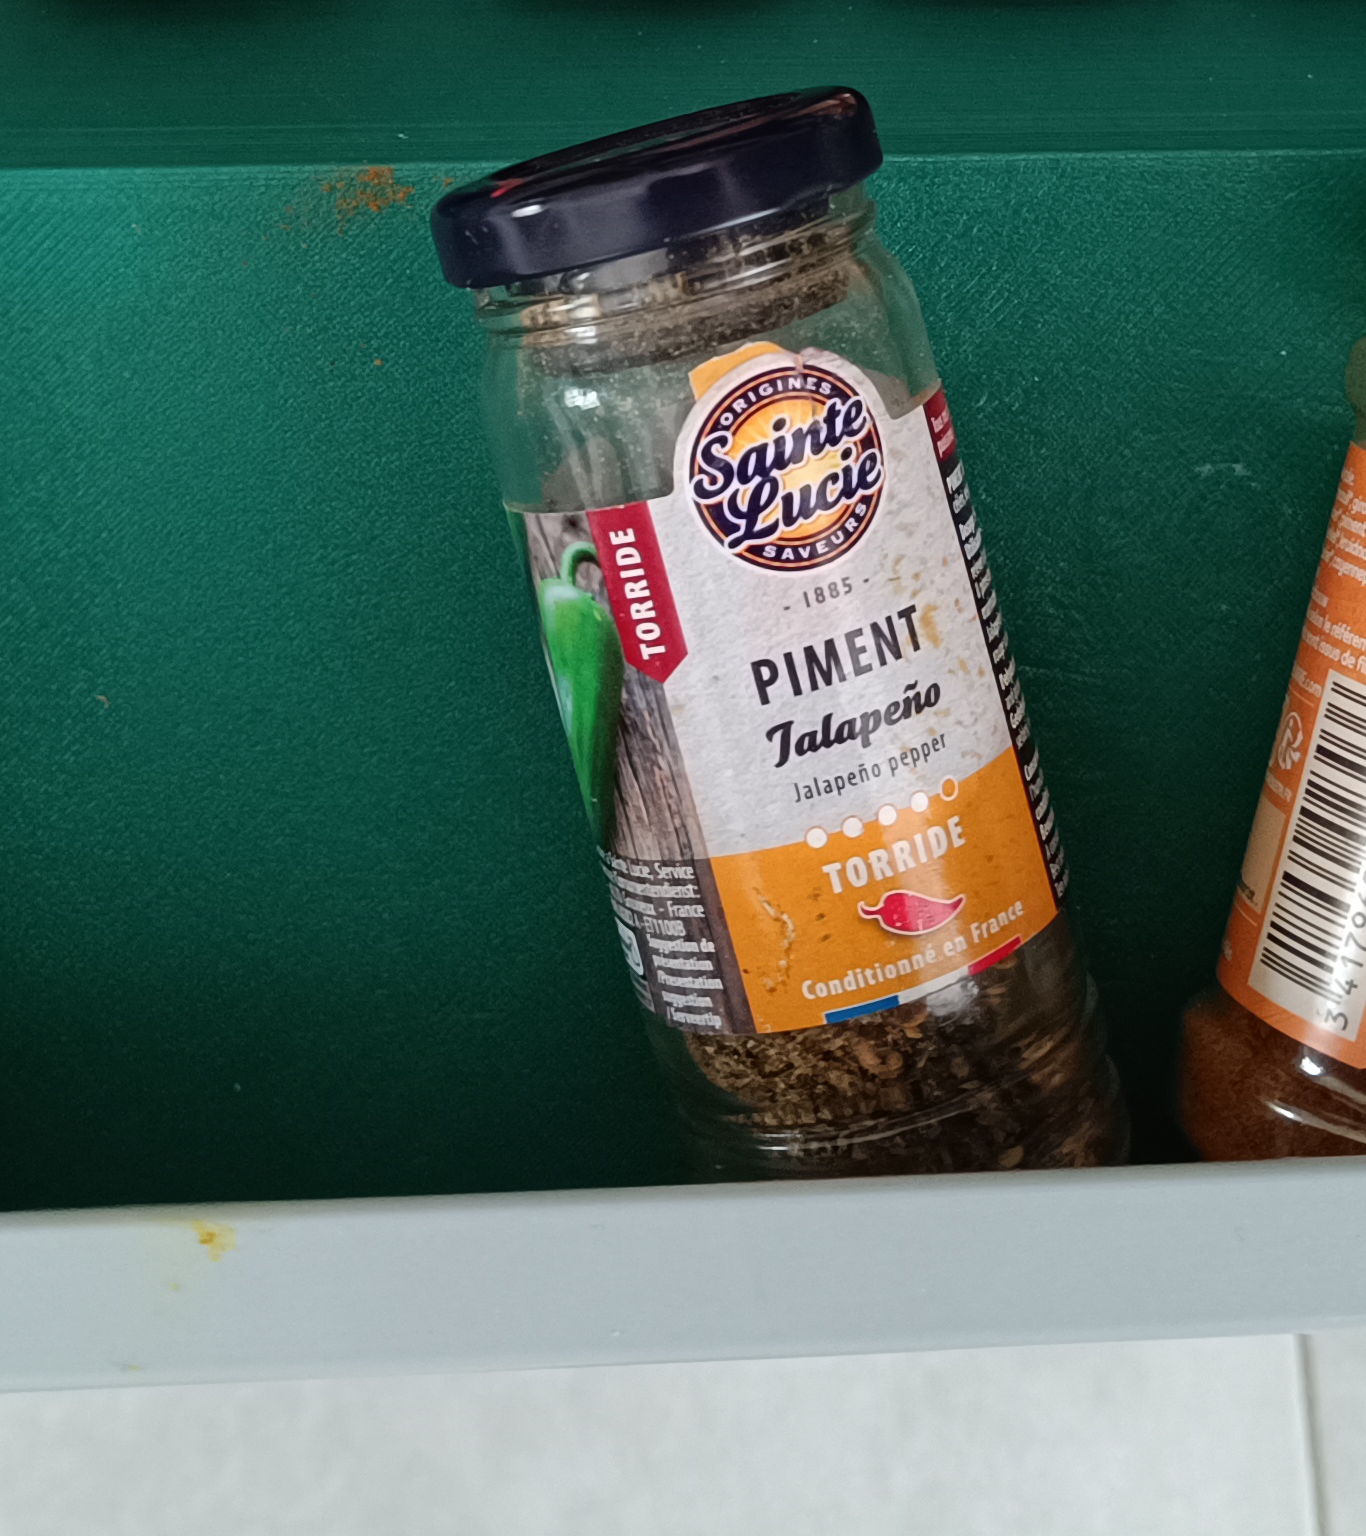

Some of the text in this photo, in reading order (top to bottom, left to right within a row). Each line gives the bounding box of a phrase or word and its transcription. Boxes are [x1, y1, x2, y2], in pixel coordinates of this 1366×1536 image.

[718, 375, 833, 428] ORIGINES
[690, 396, 868, 501] Sainte
[723, 445, 884, 550] Lucie
[761, 500, 869, 561] SAVEURS
[609, 527, 667, 660] TORRIDE
[802, 577, 854, 608] 1885
[749, 604, 922, 706] PIMENT
[1340, 649, 1356, 670] de
[765, 679, 941, 769] Jalapeño
[793, 731, 948, 804] Jalapeño pepper
[821, 814, 967, 894] TORRIDE
[667, 901, 705, 919] France
[801, 899, 1025, 1001] Conditionné en France
[1323, 1008, 1348, 1032] 3
